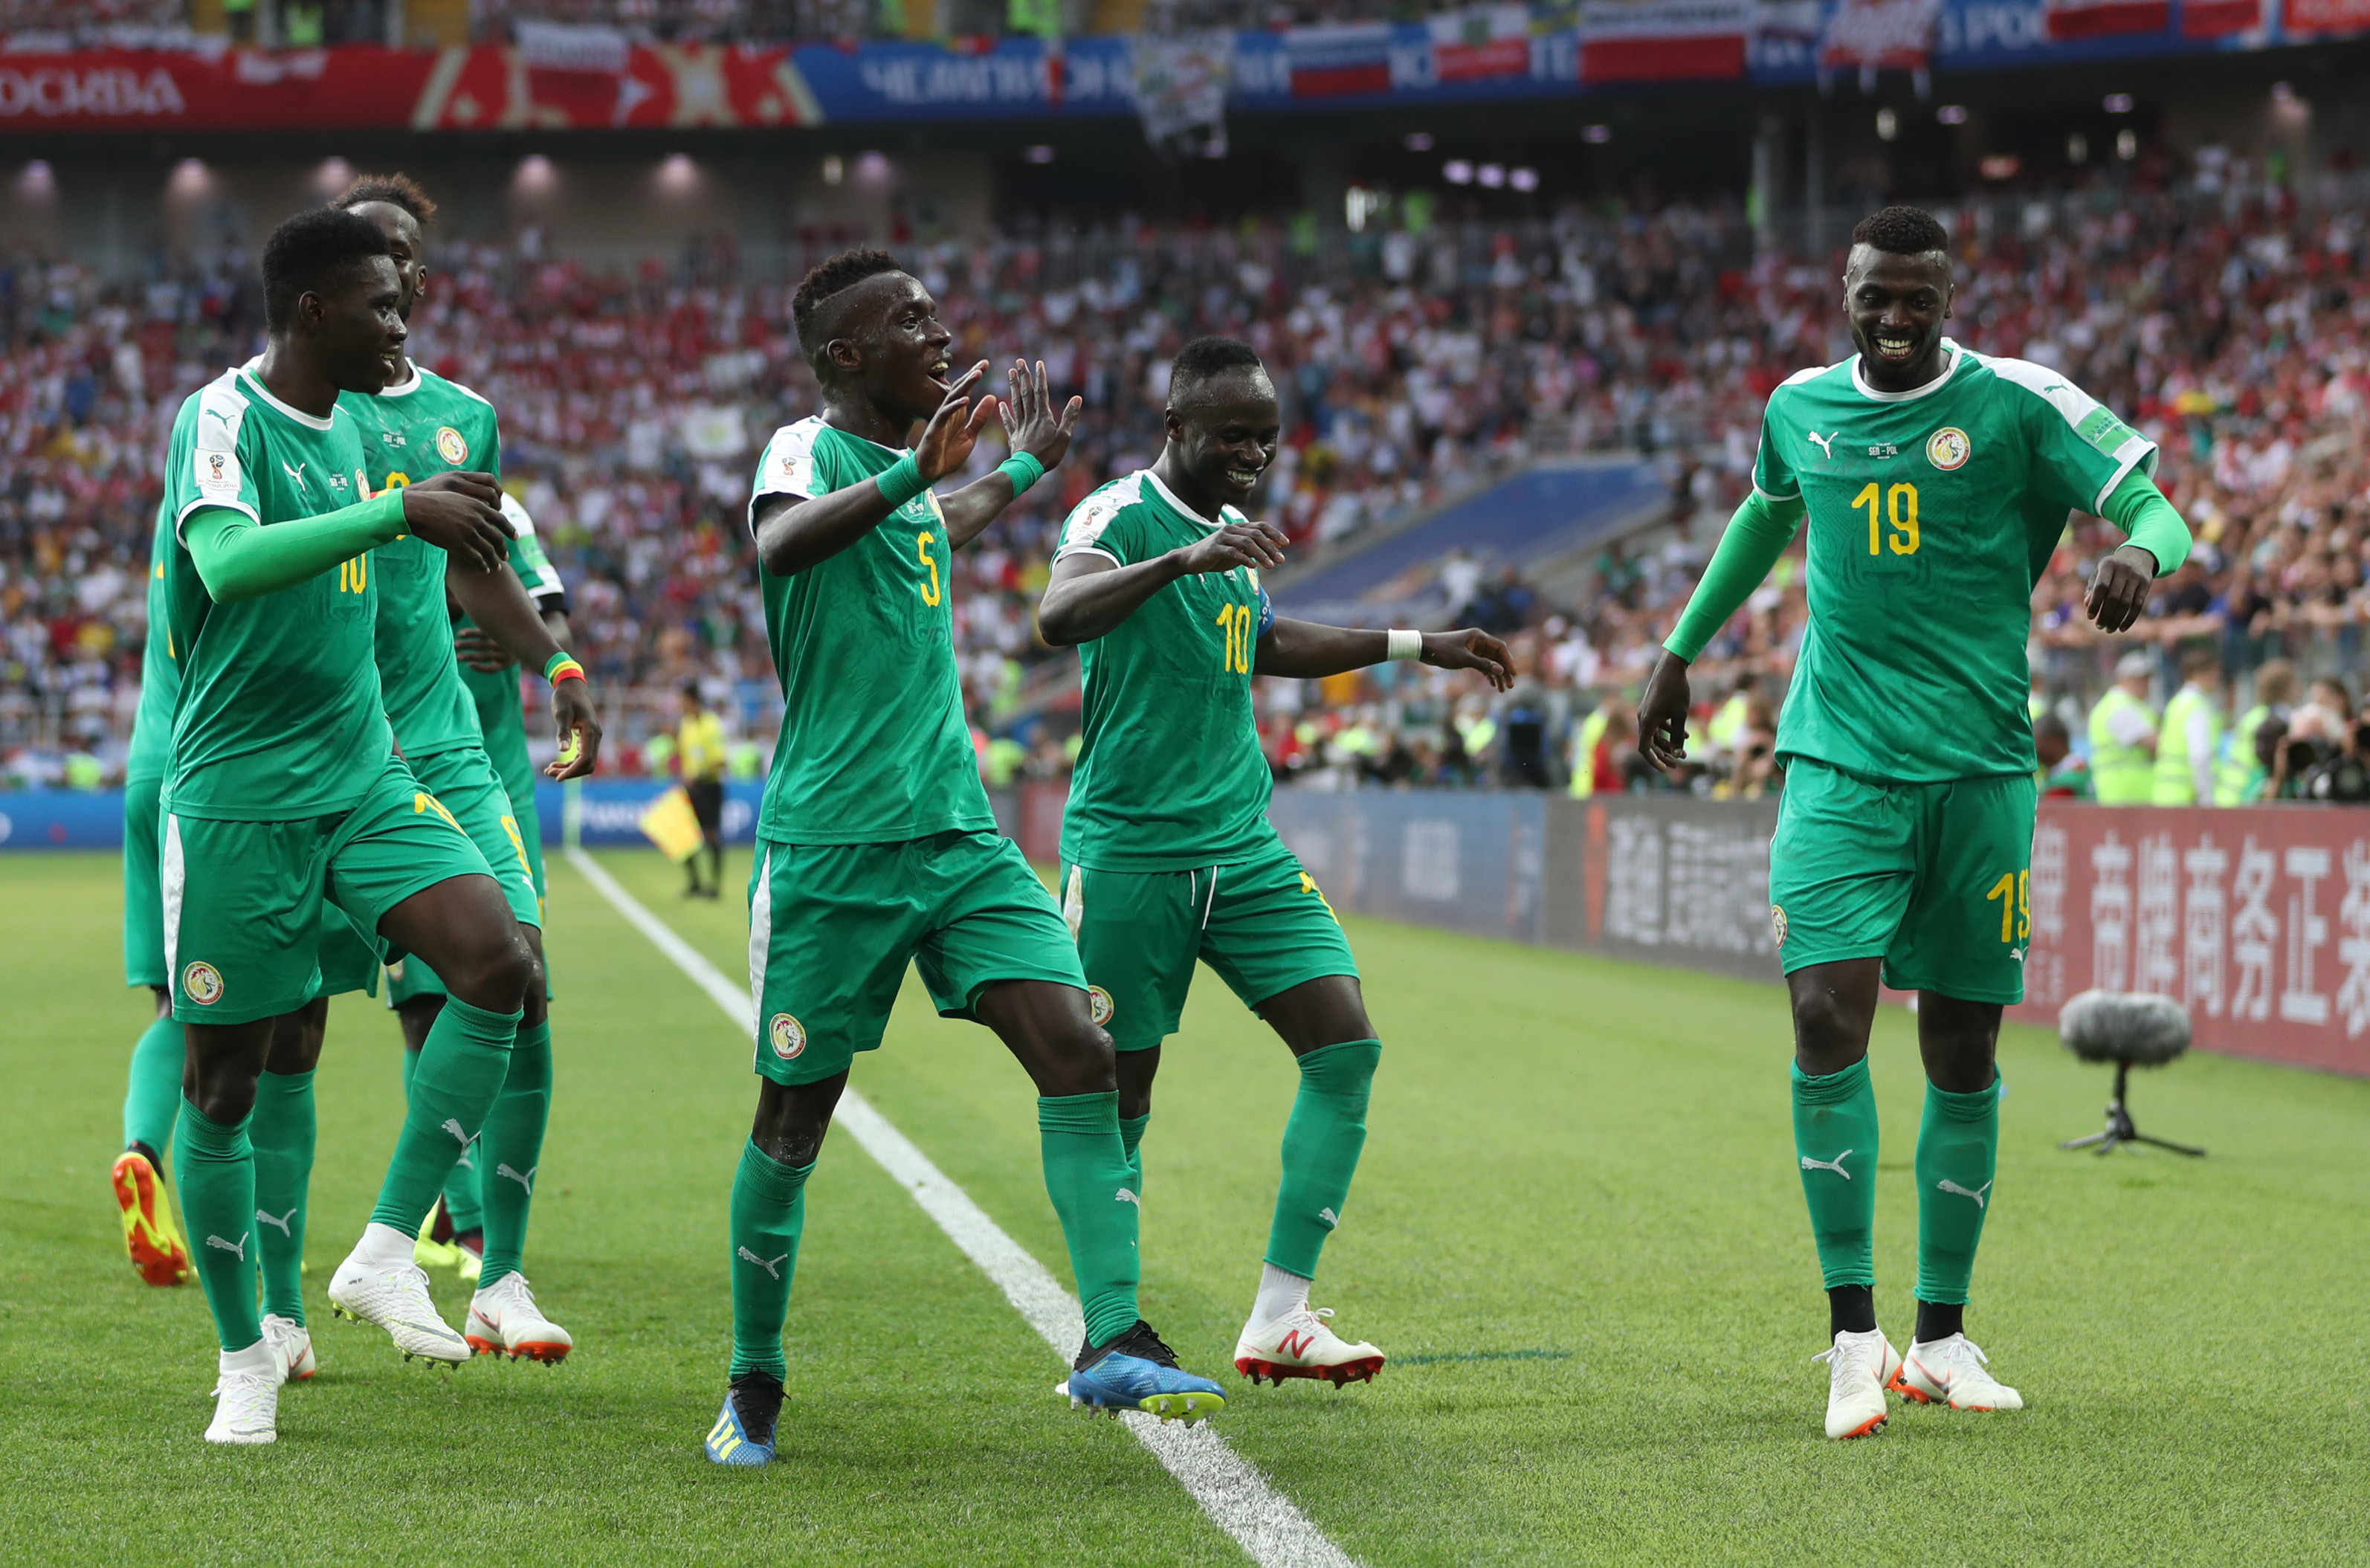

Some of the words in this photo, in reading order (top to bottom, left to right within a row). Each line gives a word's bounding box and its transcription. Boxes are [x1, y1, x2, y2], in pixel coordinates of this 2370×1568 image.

[1886, 445, 1899, 455] POL
[1851, 483, 1920, 555] 19
[917, 531, 940, 607] 5
[1215, 602, 1251, 674] 10
